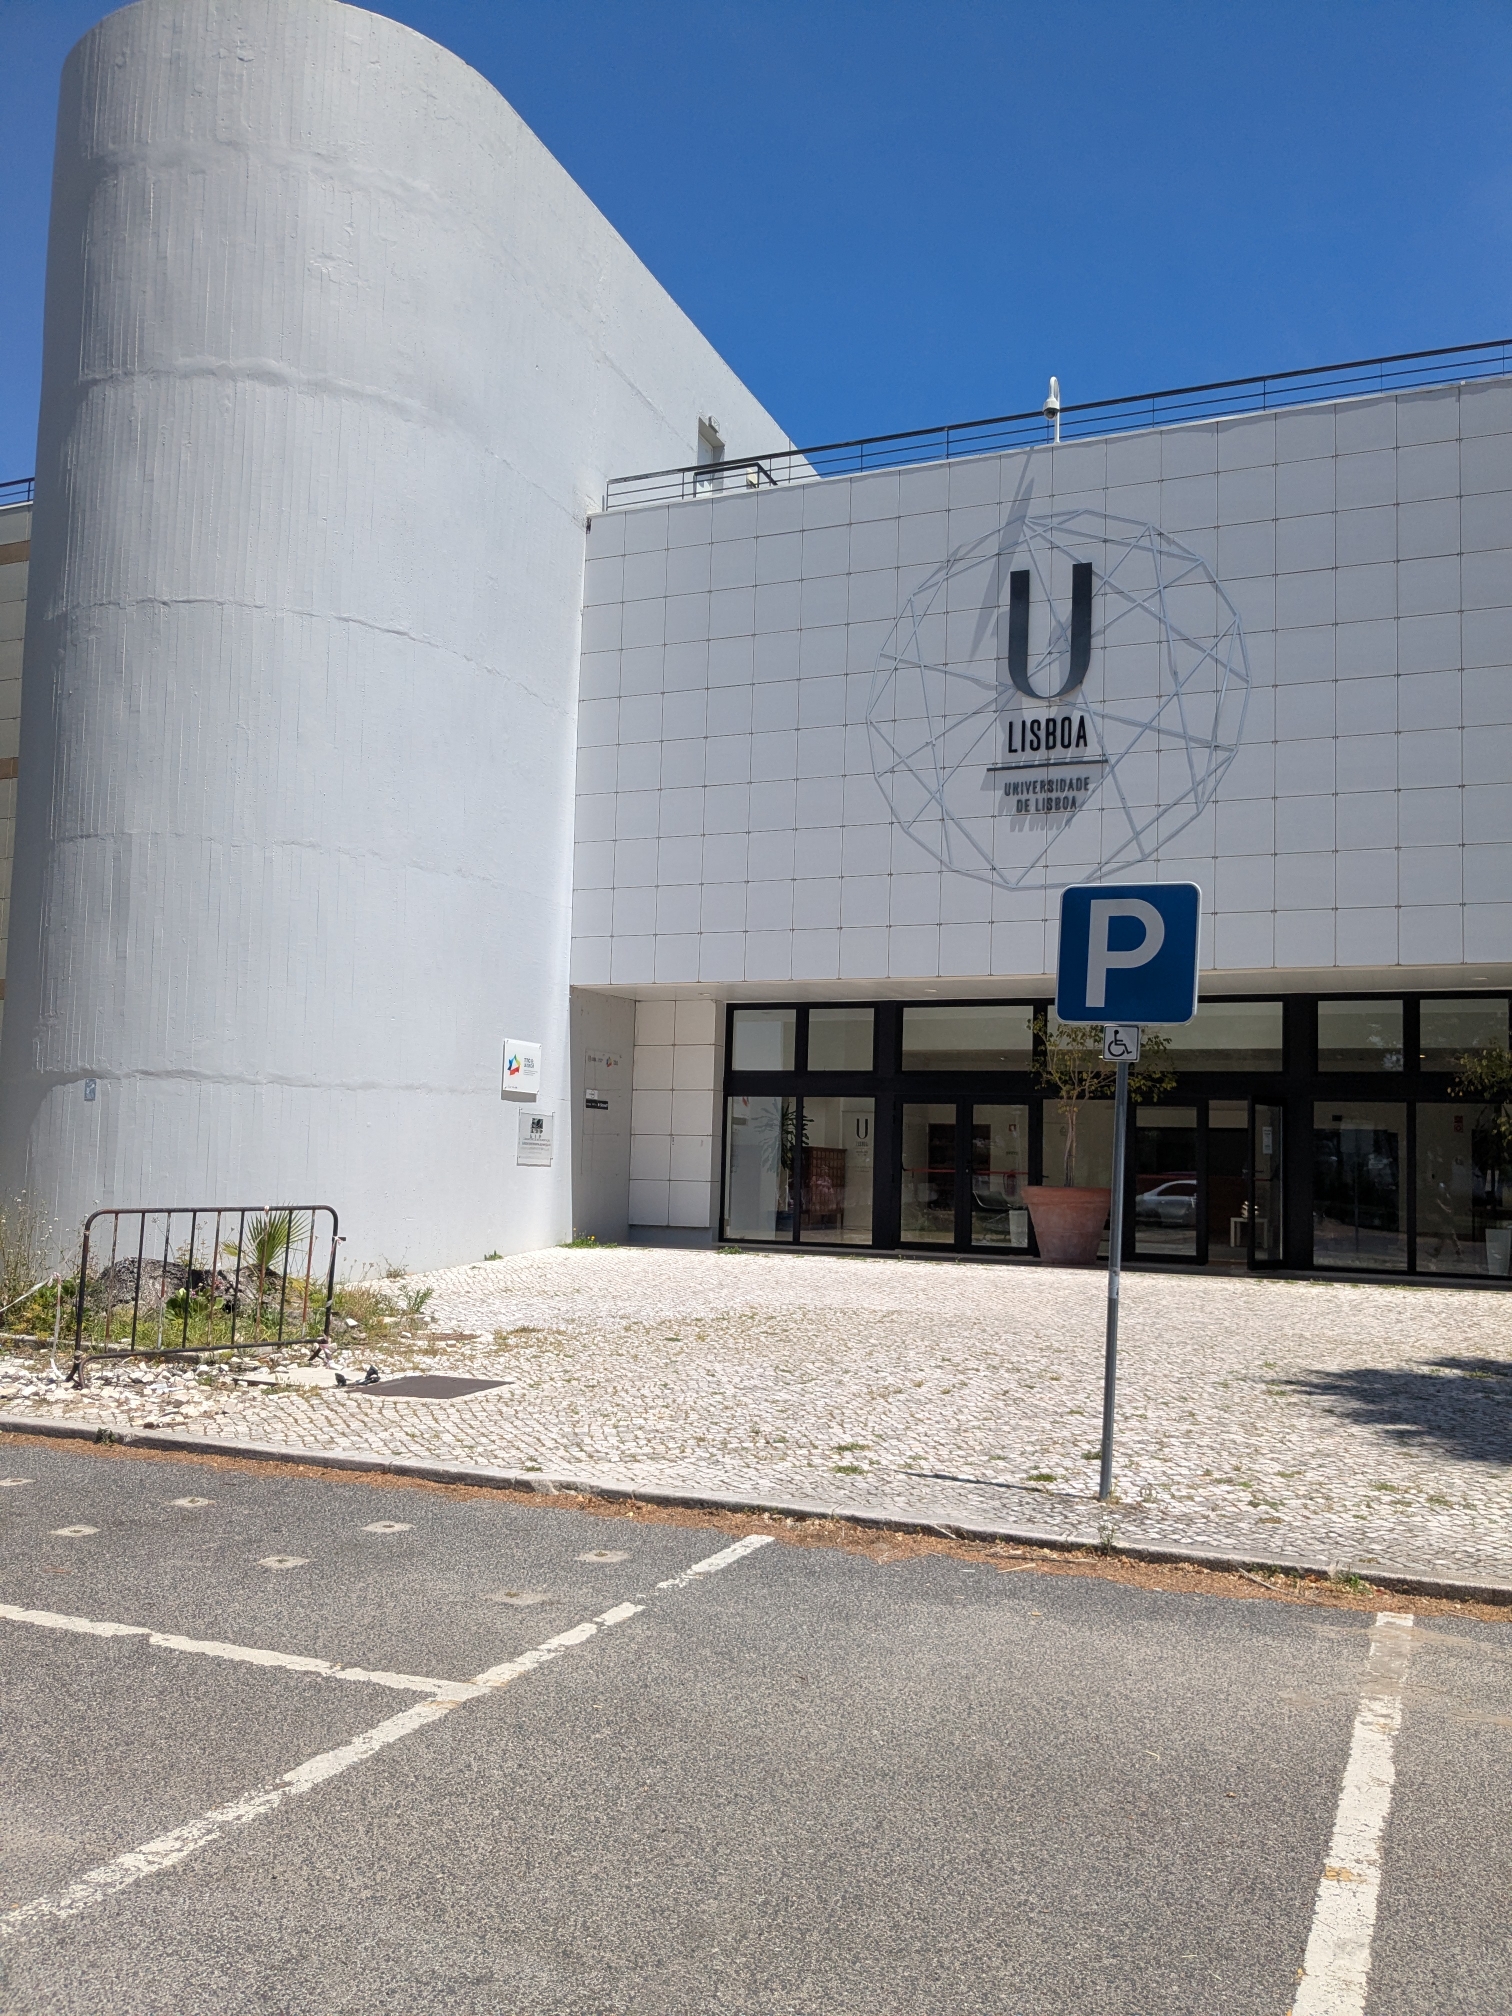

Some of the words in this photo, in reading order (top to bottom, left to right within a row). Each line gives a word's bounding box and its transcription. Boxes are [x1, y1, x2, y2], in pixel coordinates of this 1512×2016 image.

[1008, 562, 1092, 699] U
[1008, 715, 1087, 753] LISBOA
[1004, 776, 1090, 796] UNIVERSIDADE
[1016, 798, 1030, 813] DE
[1035, 796, 1077, 812] LISBOA
[1085, 898, 1165, 1007] P
[856, 1118, 869, 1139] U
